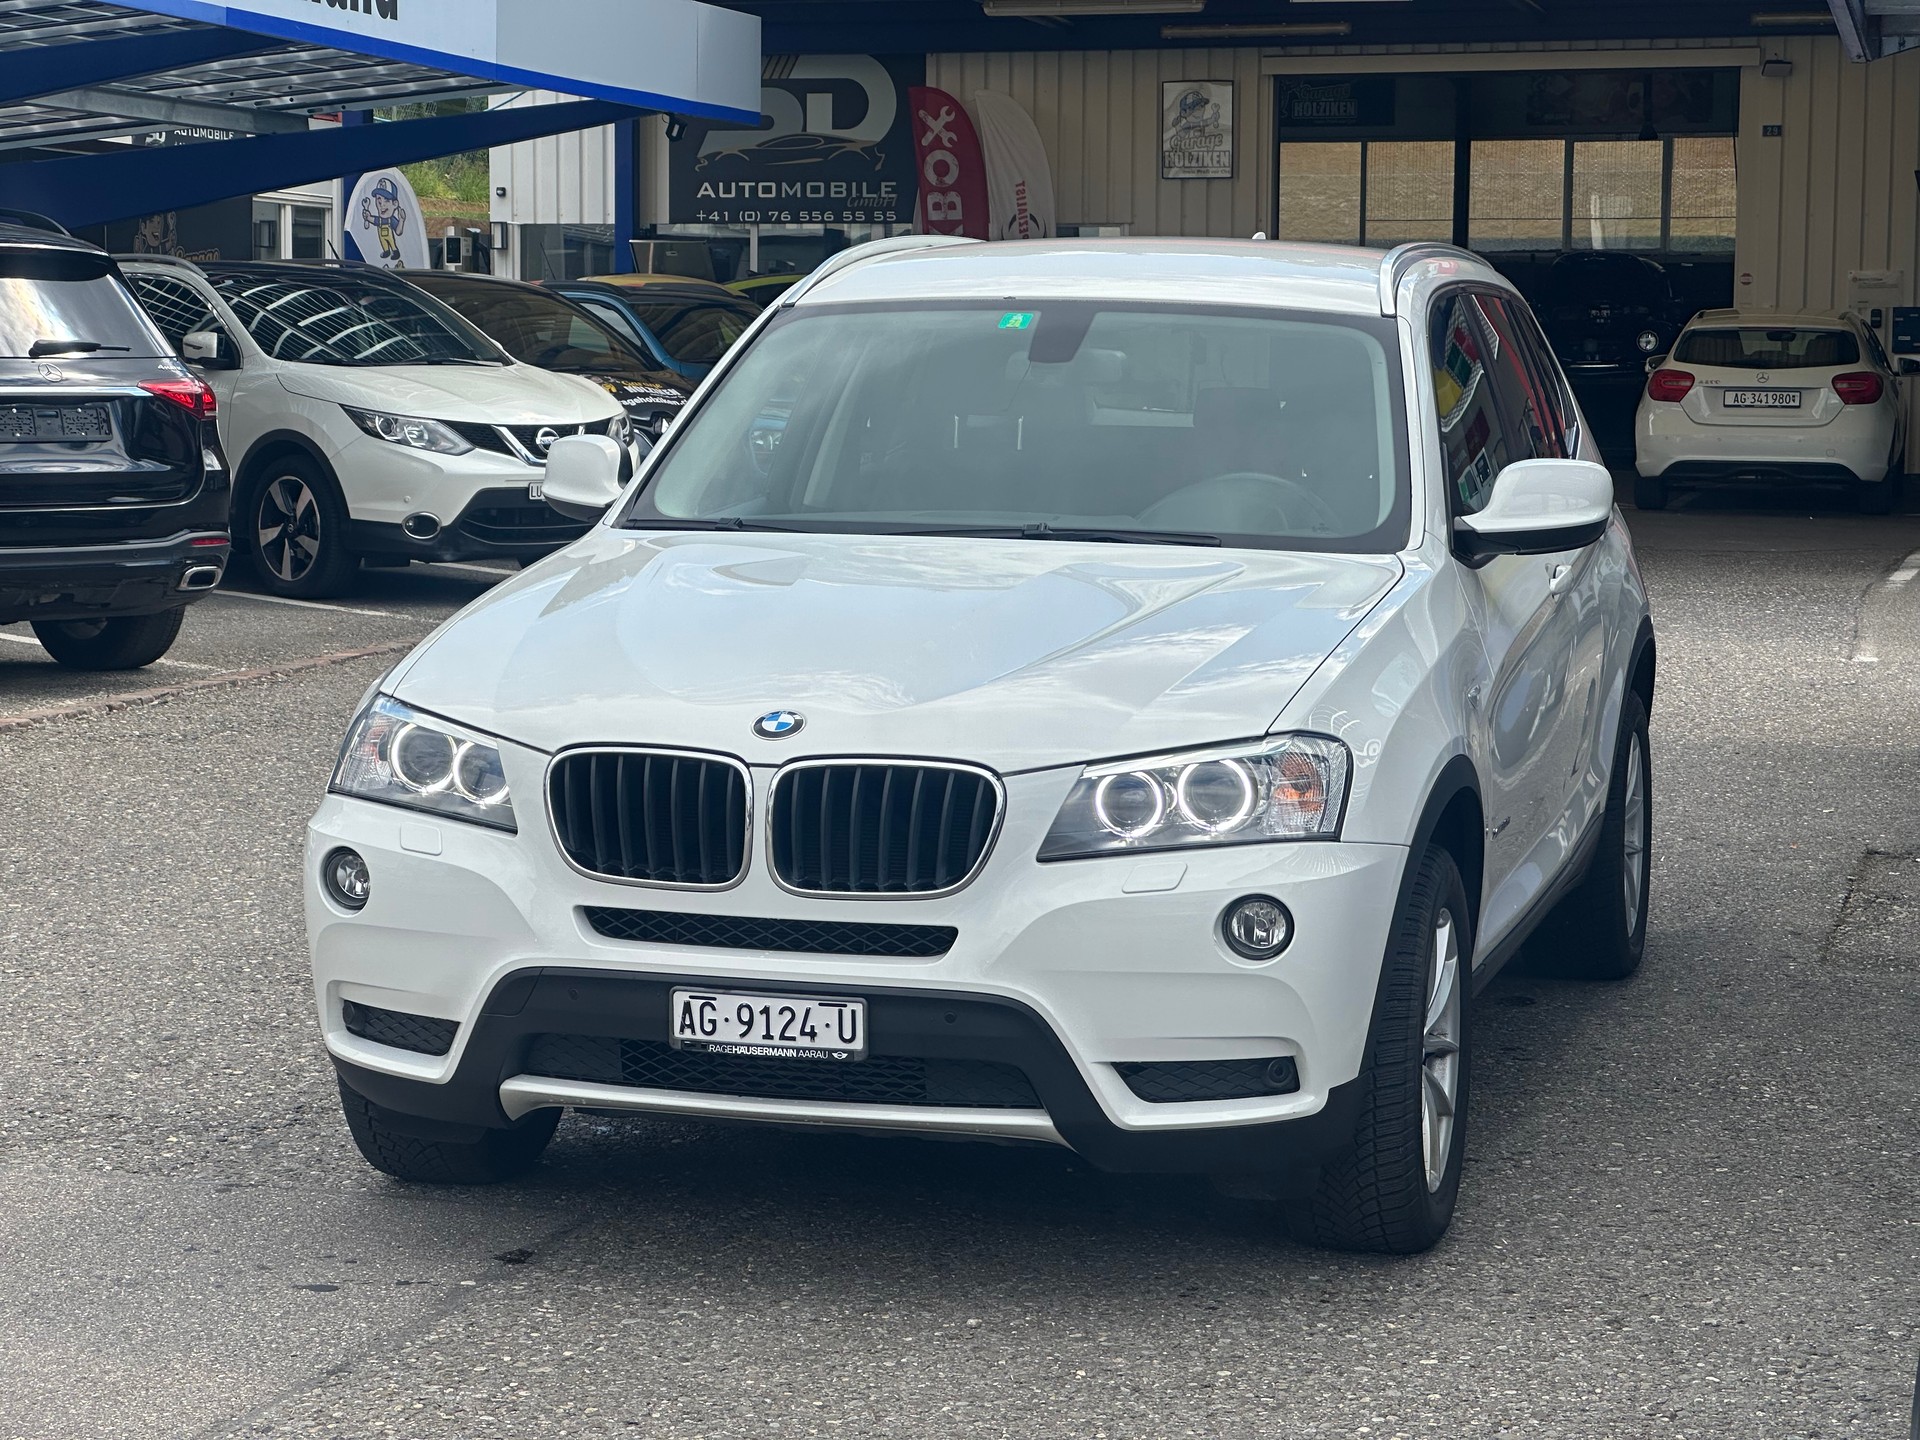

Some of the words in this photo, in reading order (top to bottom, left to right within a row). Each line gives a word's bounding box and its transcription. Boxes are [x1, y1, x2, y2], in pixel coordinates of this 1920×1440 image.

[1766, 127, 1778, 136] 29
[1164, 151, 1230, 167] HOLZIKEN
[696, 181, 897, 198] AUTOMOBILE
[696, 209, 729, 222] +41
[739, 210, 761, 222] (0)
[768, 210, 791, 222] 76
[800, 210, 834, 222] 556
[842, 210, 865, 222] 55
[873, 210, 897, 222] 55
[798, 1050, 829, 1060] AARAU
